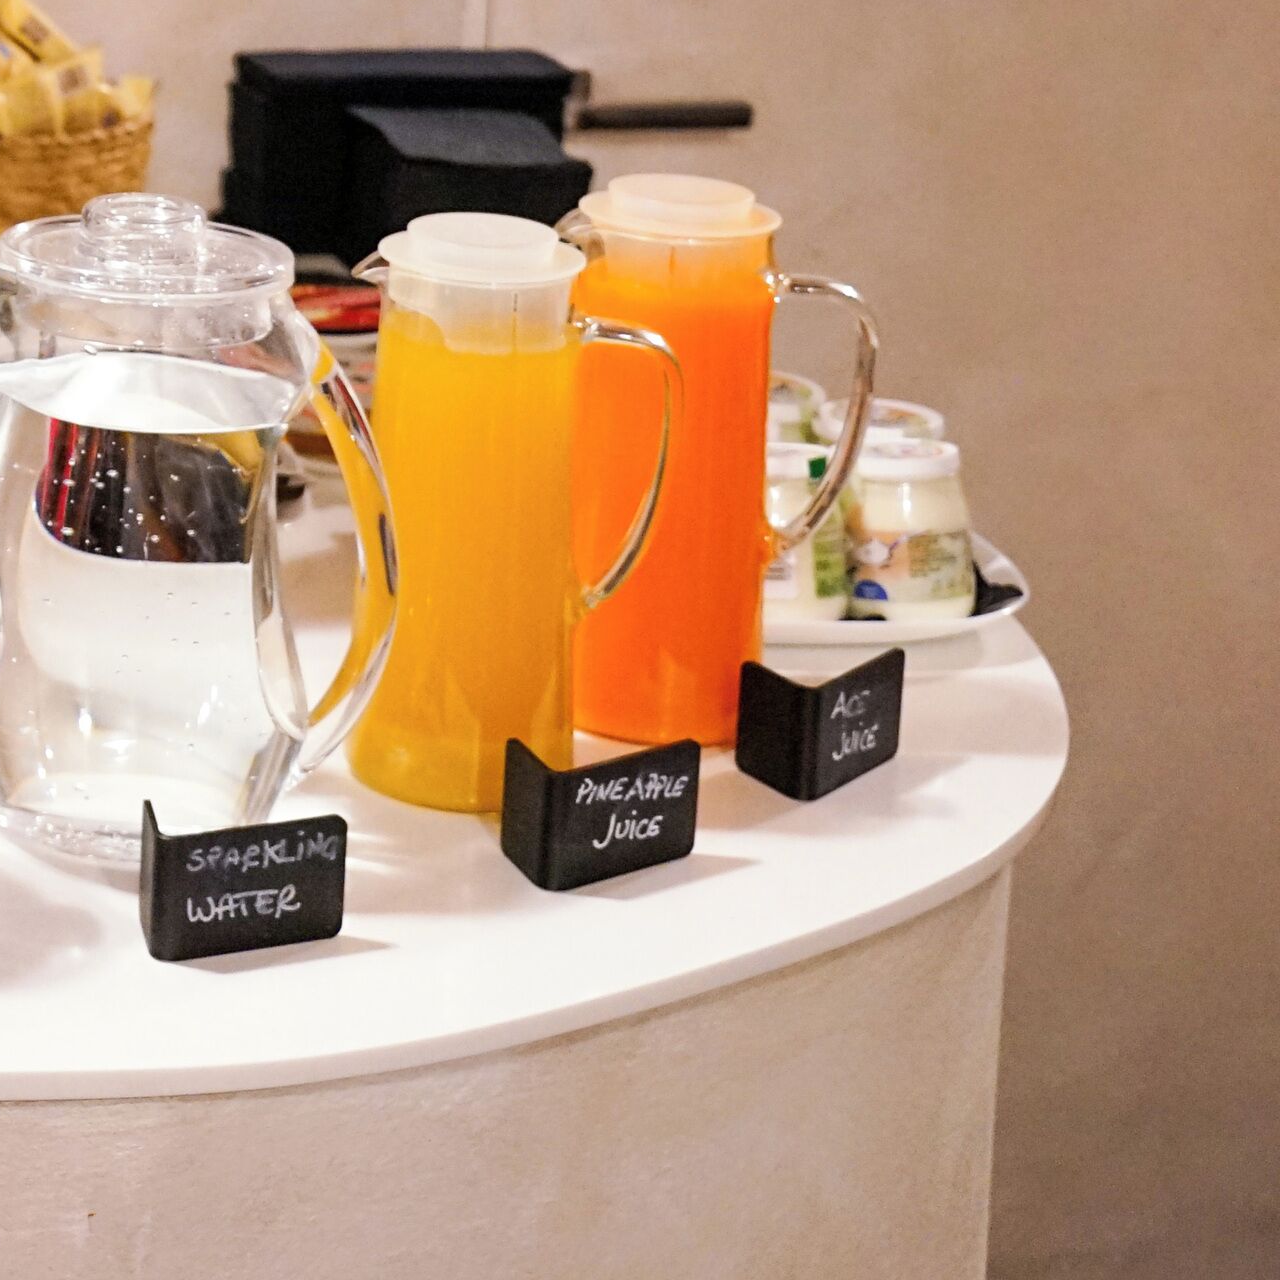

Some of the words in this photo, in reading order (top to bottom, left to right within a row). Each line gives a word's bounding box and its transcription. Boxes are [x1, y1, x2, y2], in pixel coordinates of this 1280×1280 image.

[575, 773, 689, 805] PINEAPPLE
[592, 809, 664, 850] JUICE
[185, 829, 339, 873] SPARKLING
[186, 883, 302, 924] WATER
